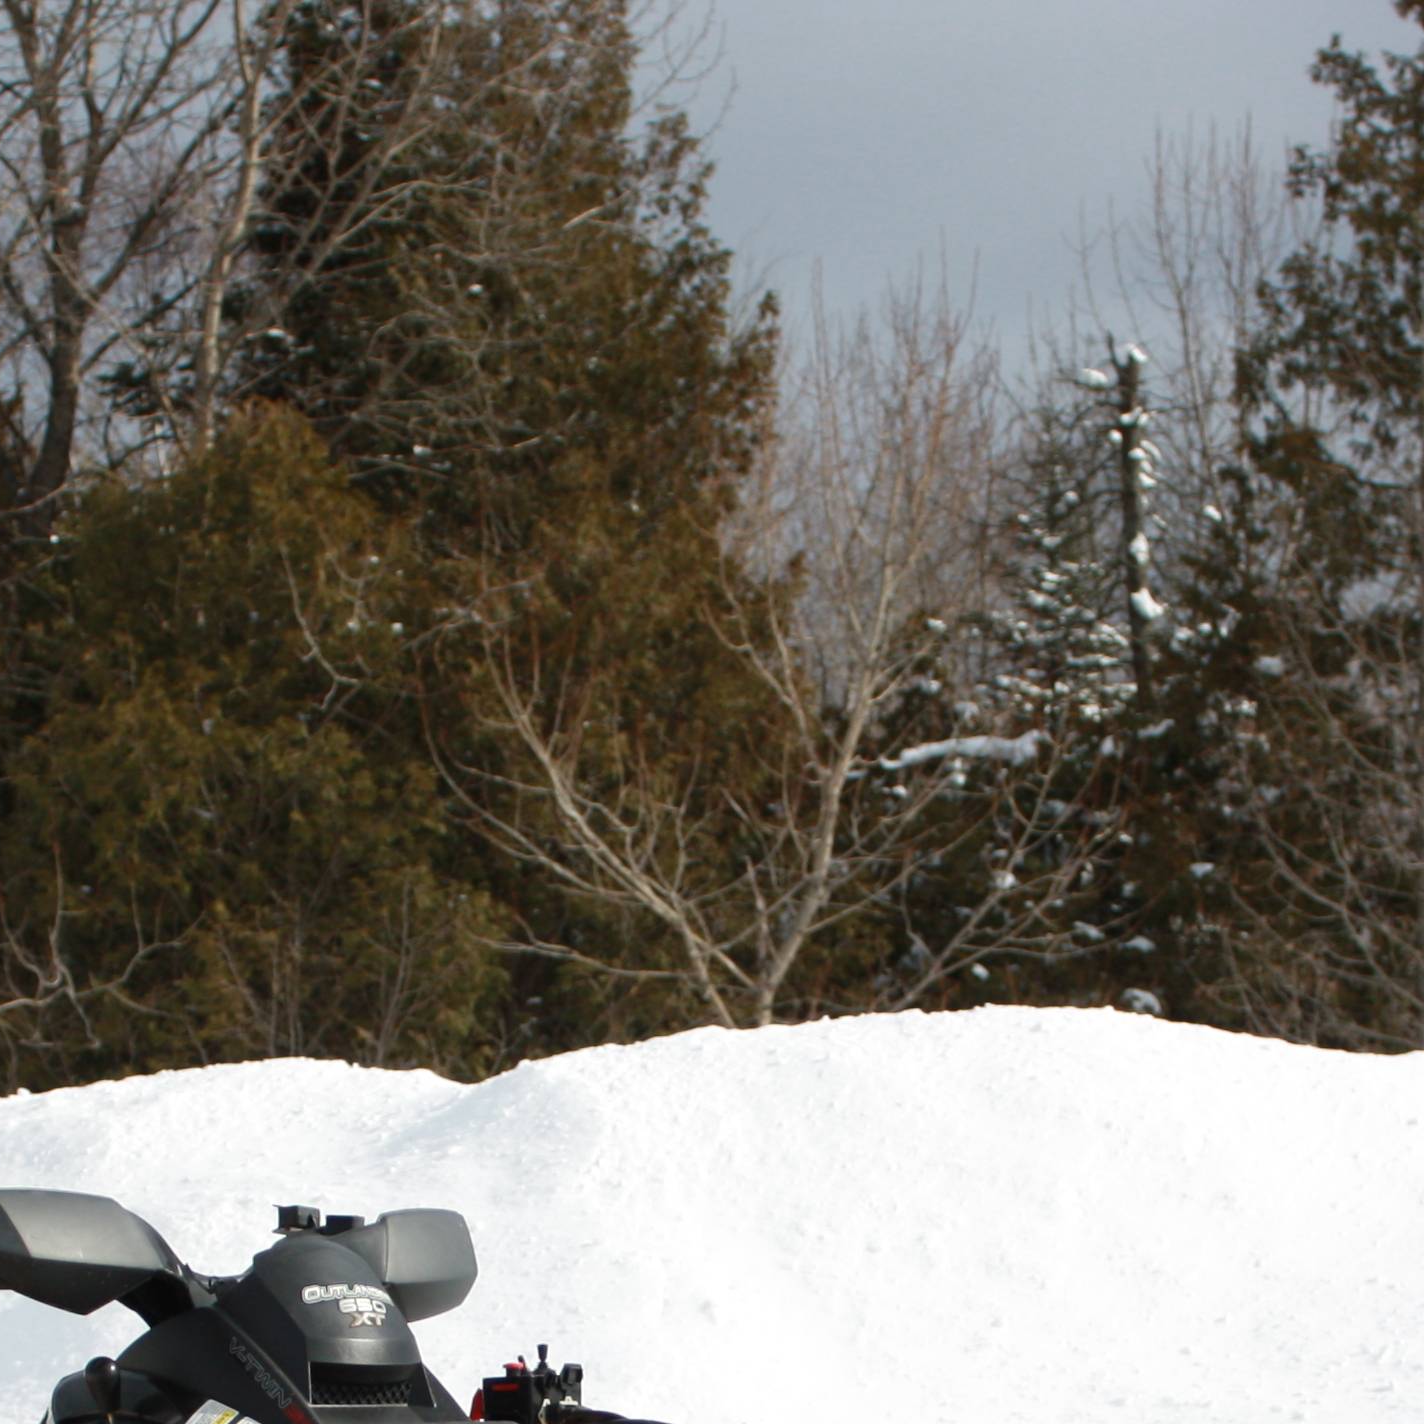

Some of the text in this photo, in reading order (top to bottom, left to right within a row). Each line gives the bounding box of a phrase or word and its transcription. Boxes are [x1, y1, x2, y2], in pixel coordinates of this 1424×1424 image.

[339, 1299, 387, 1314] 650
[350, 1312, 386, 1328] XT
[228, 1335, 292, 1409] V-TWIN
